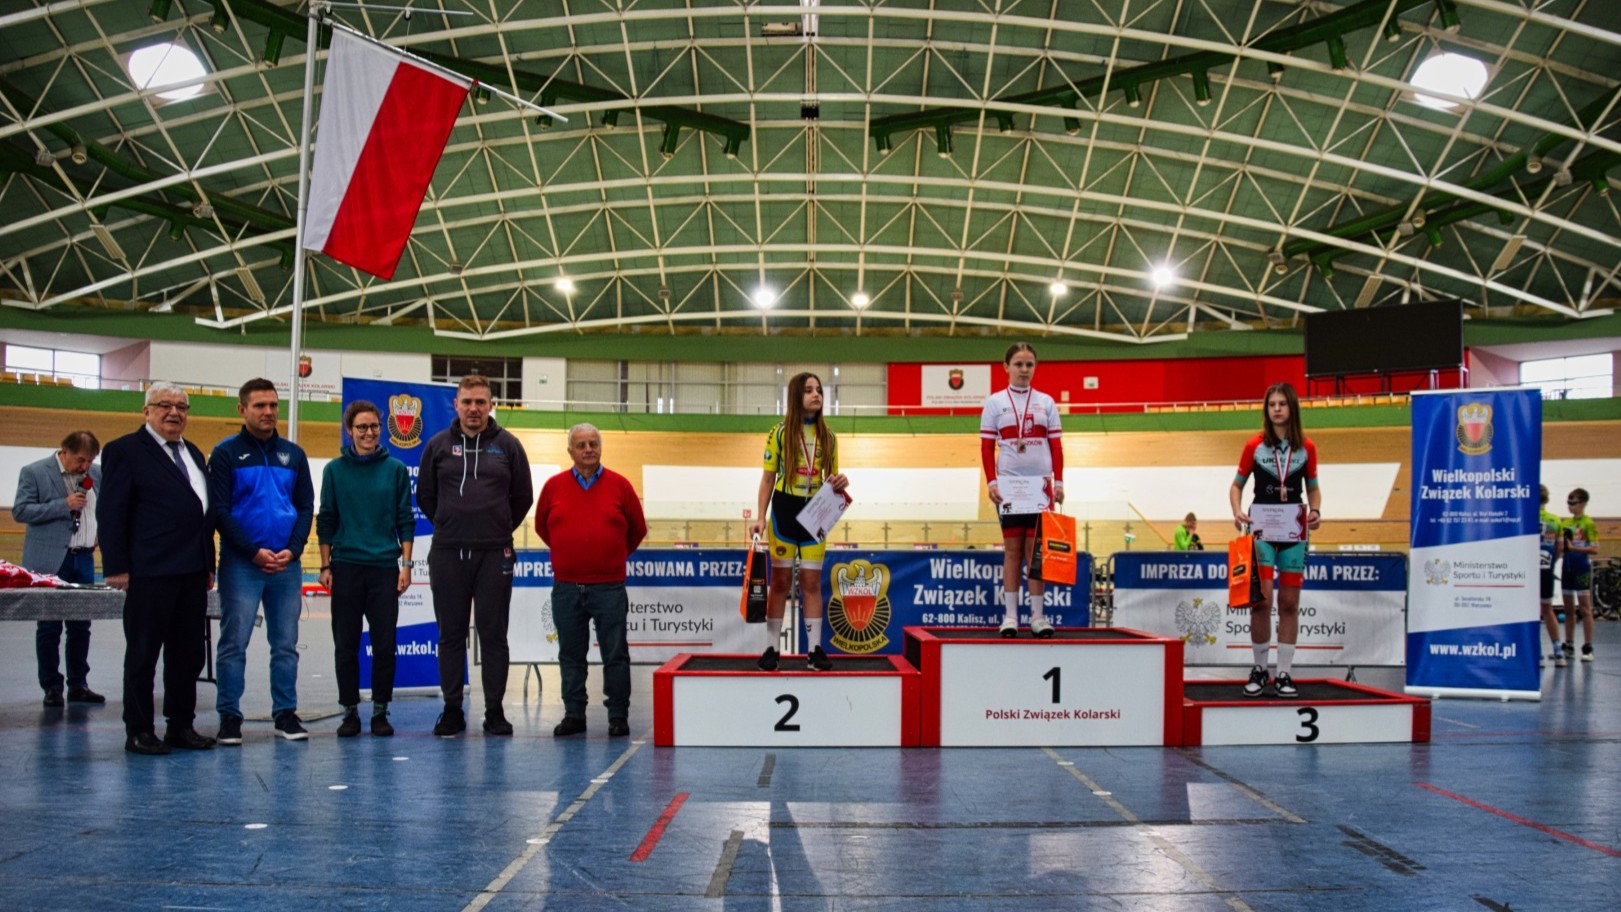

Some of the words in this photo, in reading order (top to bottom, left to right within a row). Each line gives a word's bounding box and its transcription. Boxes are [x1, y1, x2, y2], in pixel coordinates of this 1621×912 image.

[1432, 468, 1515, 484] Wielkopolski
[1421, 485, 1472, 503] Związek
[1475, 484, 1530, 499] Kolarski
[700, 561, 747, 577] PRZEZ:
[1140, 564, 1204, 580] IMPREZA
[1333, 565, 1380, 581] PRZEZ:
[1453, 561, 1508, 569] Ministerstwo
[1453, 571, 1480, 580] Sportu
[1487, 571, 1525, 580] Turystyki
[848, 586, 874, 595] WZKOL
[913, 585, 987, 611] Związek
[994, 585, 1072, 606] Klaski
[642, 618, 646, 631] i
[650, 618, 713, 634] Turystyki
[922, 613, 955, 624] 62-800
[957, 613, 986, 625] Kalisz,
[988, 614, 1000, 624] ul.
[1056, 615, 1062, 624] 2
[833, 635, 885, 651] WIELKOPOLSKA
[1429, 642, 1516, 659] www.wzkol.pl
[1042, 667, 1061, 704] 1
[774, 694, 800, 732] 2
[985, 709, 1020, 719] Polski
[1023, 709, 1070, 722] Związek
[1073, 709, 1121, 719] Kolarski
[1296, 707, 1320, 743] 3
